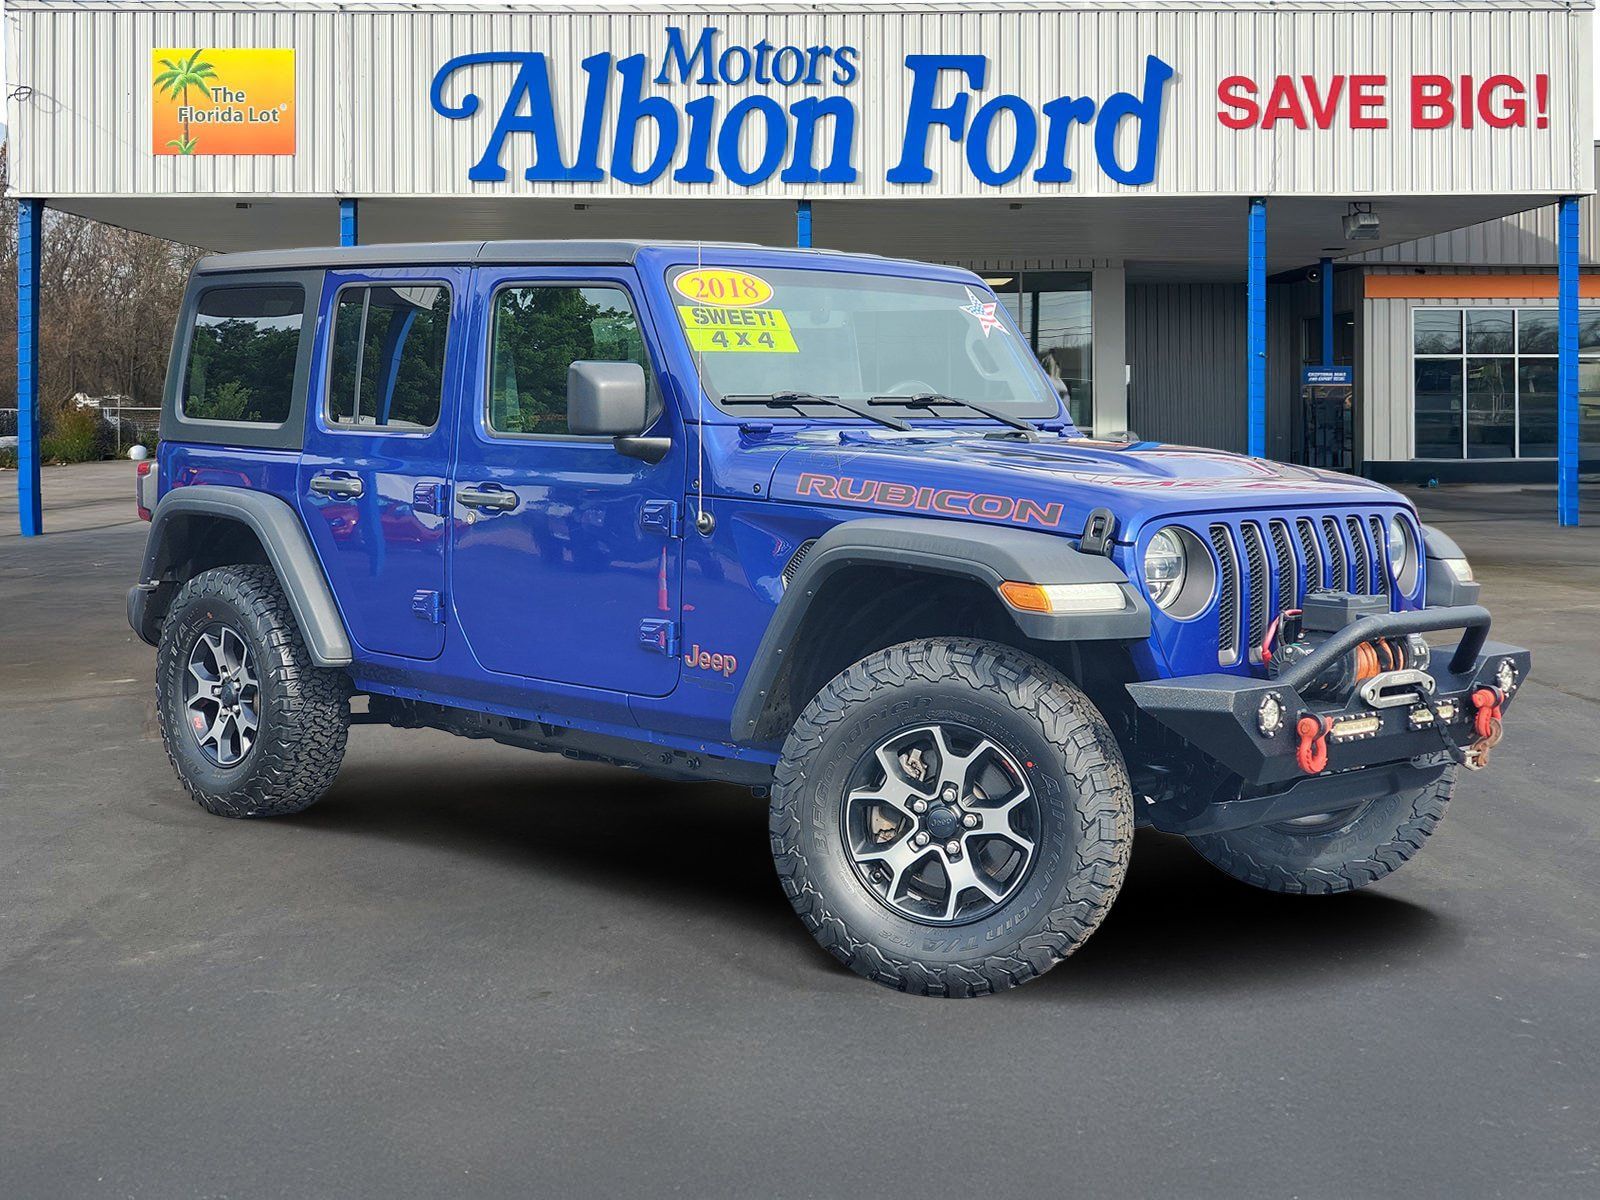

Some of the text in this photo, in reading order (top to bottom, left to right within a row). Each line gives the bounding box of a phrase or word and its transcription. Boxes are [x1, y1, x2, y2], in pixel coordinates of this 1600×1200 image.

[653, 26, 859, 85] Motors
[178, 107, 279, 122] Florida Lot
[211, 86, 245, 103] The
[1217, 74, 1548, 129] SAVE BIG!
[430, 51, 1174, 186] Albion Ford
[691, 277, 759, 299] 2018
[692, 308, 776, 326] SWEET!
[796, 473, 1064, 527] RUBICON
[685, 644, 736, 677] Jeep
[813, 697, 934, 855] BFGoodrich
